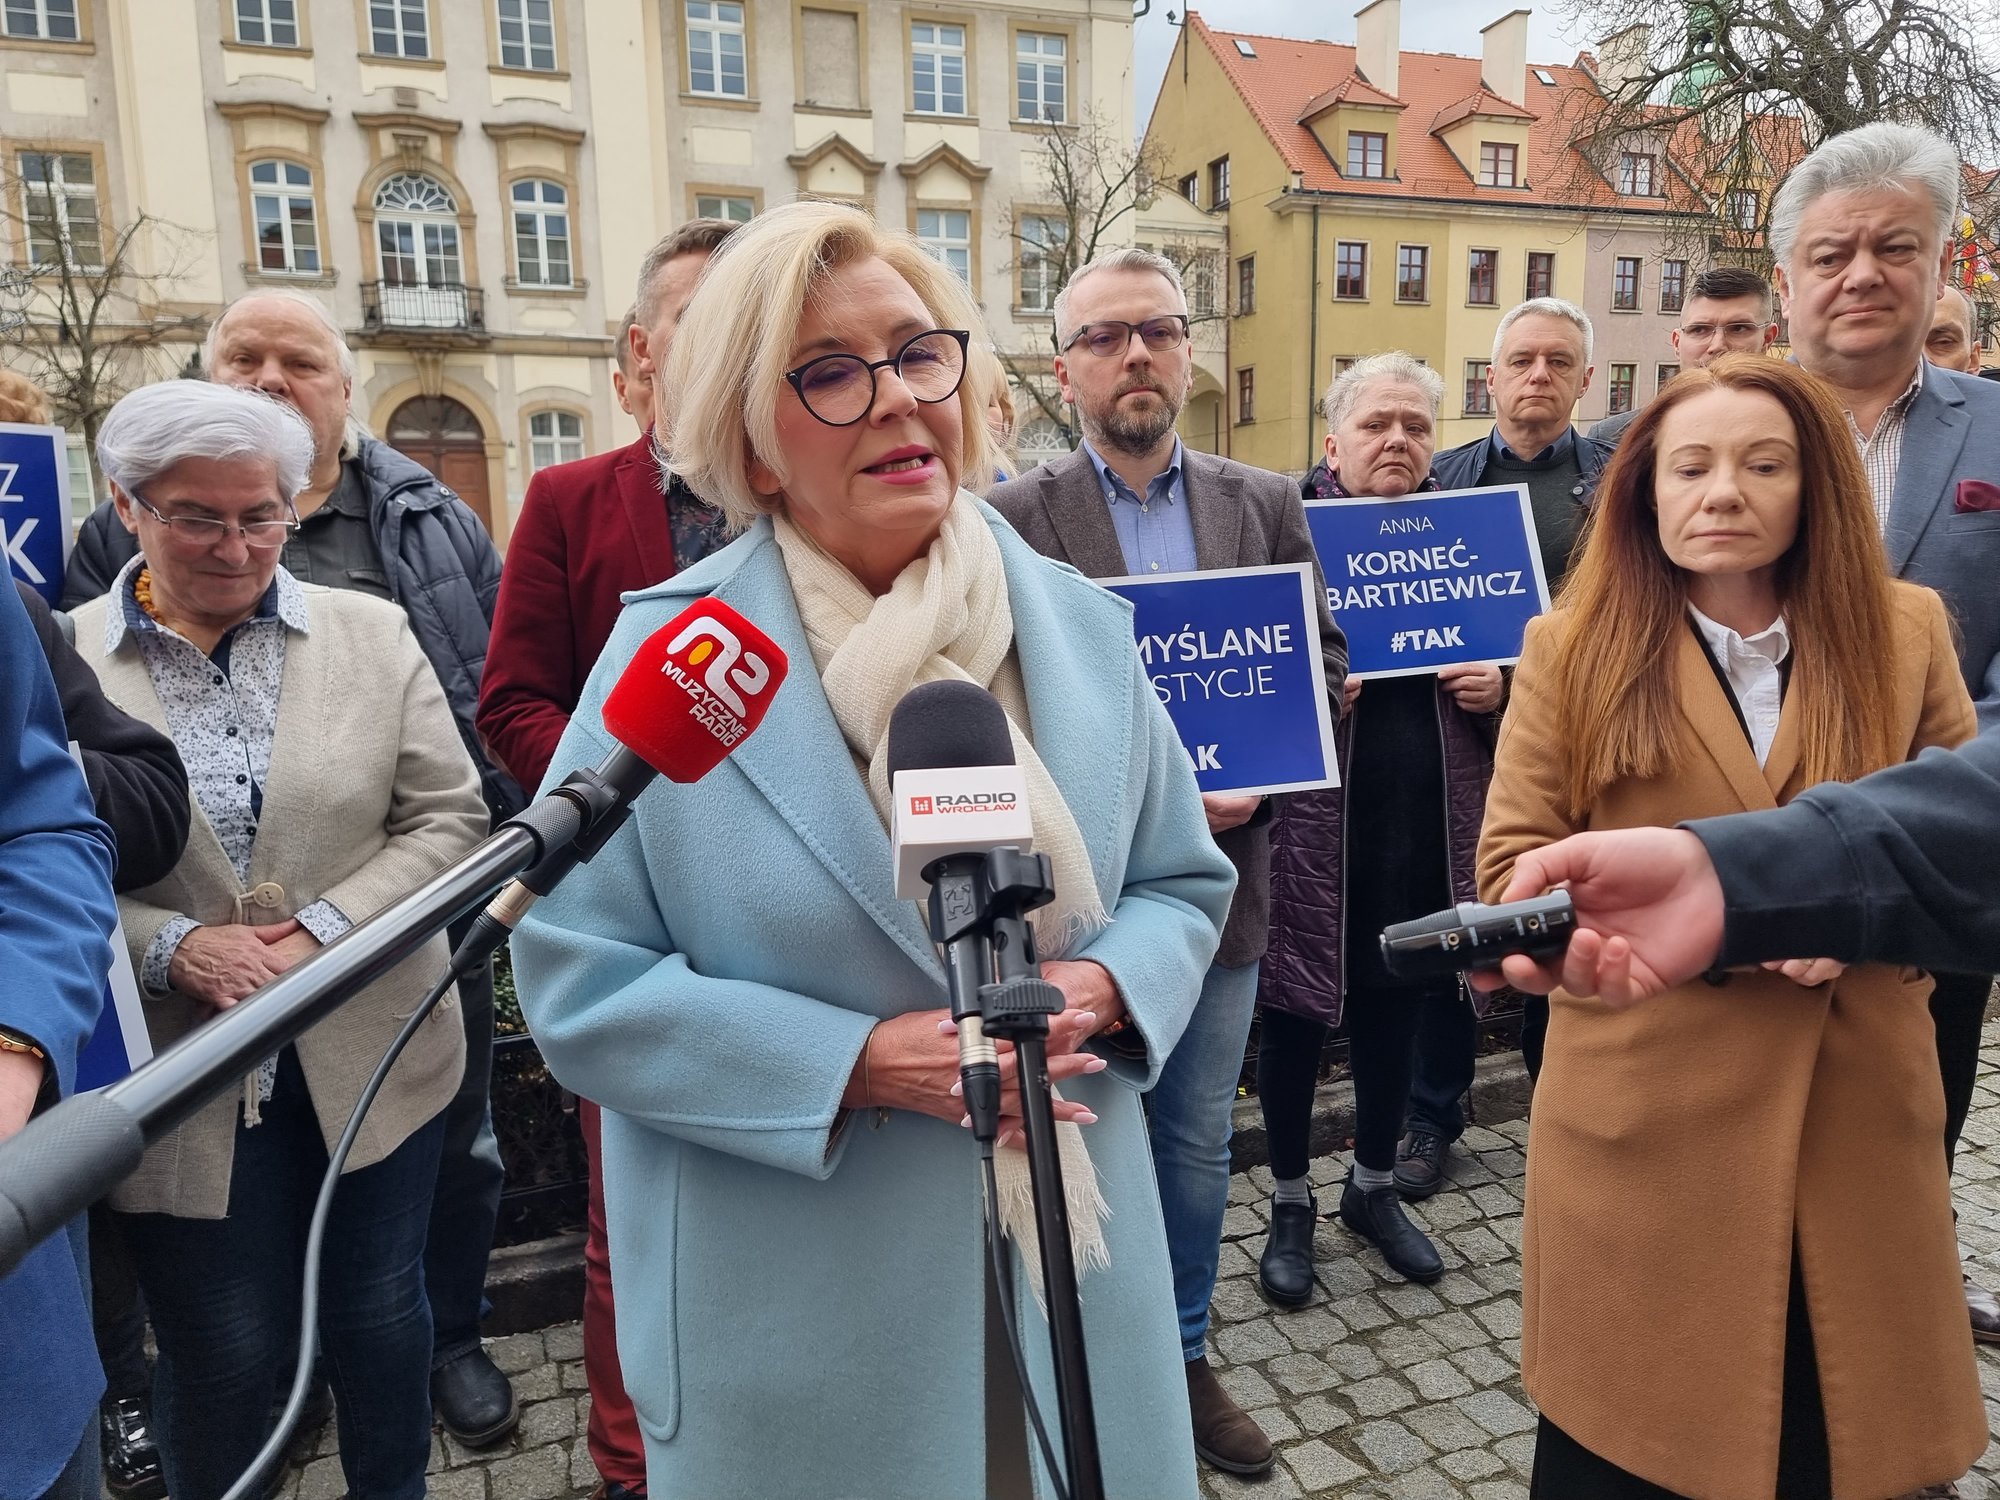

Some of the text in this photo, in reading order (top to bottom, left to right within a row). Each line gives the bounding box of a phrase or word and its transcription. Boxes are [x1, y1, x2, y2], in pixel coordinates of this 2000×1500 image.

[1379, 516, 1435, 535] ANNA
[1346, 538, 1479, 577] KORNEĆ-
[1326, 571, 1527, 611] BARTKIEWICZ
[1391, 625, 1465, 653] #TAK
[660, 659, 748, 739] MUZYCZNE
[688, 702, 737, 747] RADIO
[936, 792, 1016, 806] RADIO
[937, 803, 1016, 813] WROCŁAW
